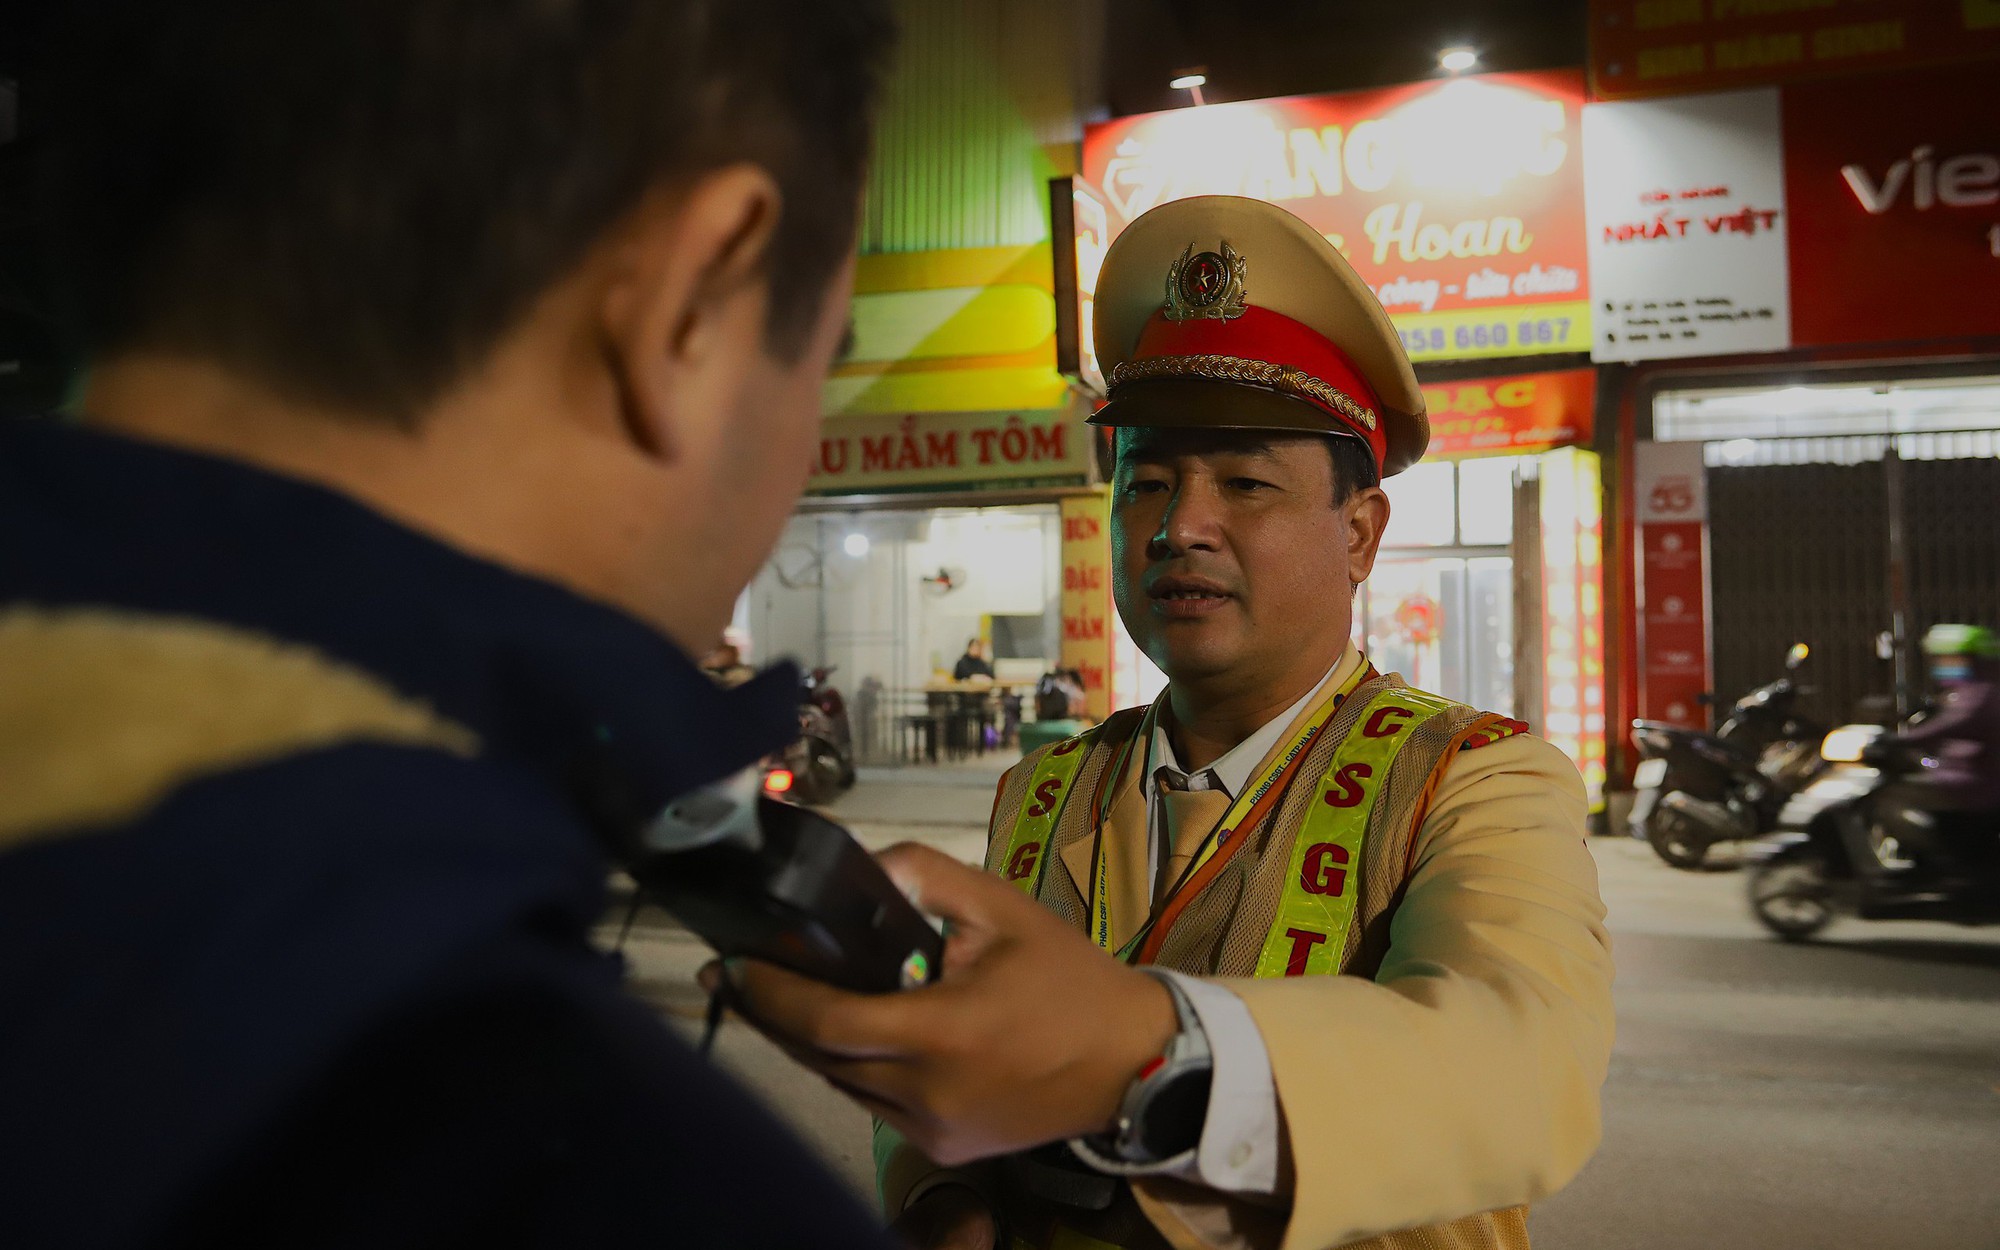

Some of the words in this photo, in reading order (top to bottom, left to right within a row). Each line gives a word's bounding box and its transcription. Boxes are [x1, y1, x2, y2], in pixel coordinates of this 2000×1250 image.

[1364, 200, 1534, 265] Hoan
[1603, 208, 1690, 243] NHẤT
[1704, 203, 1778, 239] VIỆT
[971, 416, 1067, 465] TÔM
[1268, 765, 1285, 782] CSGT
